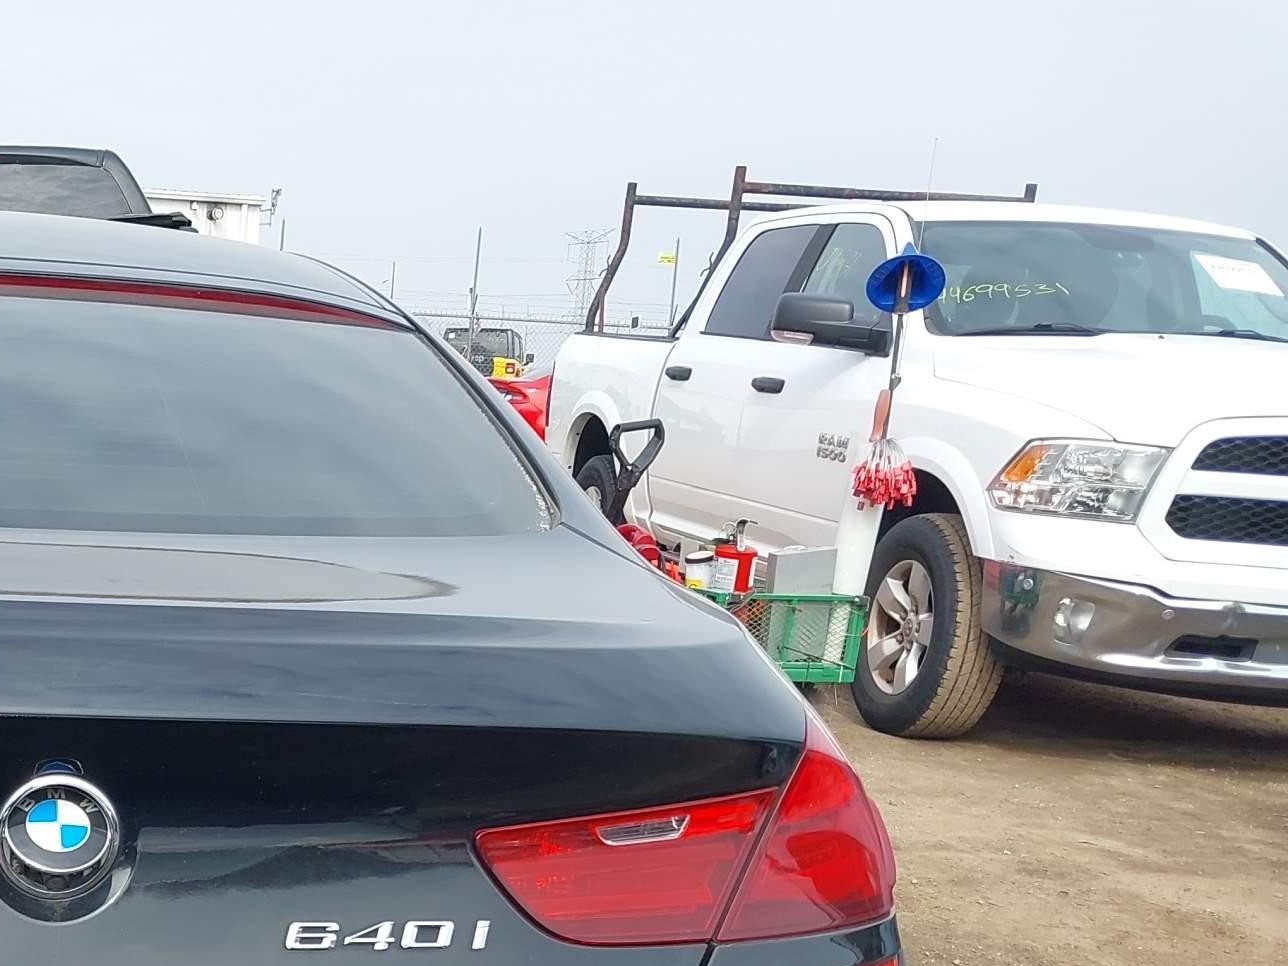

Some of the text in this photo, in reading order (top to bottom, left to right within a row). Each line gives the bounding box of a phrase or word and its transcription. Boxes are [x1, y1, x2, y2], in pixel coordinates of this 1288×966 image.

[818, 432, 850, 449] RAM
[817, 446, 847, 463] 1500
[17, 788, 99, 814] BMW
